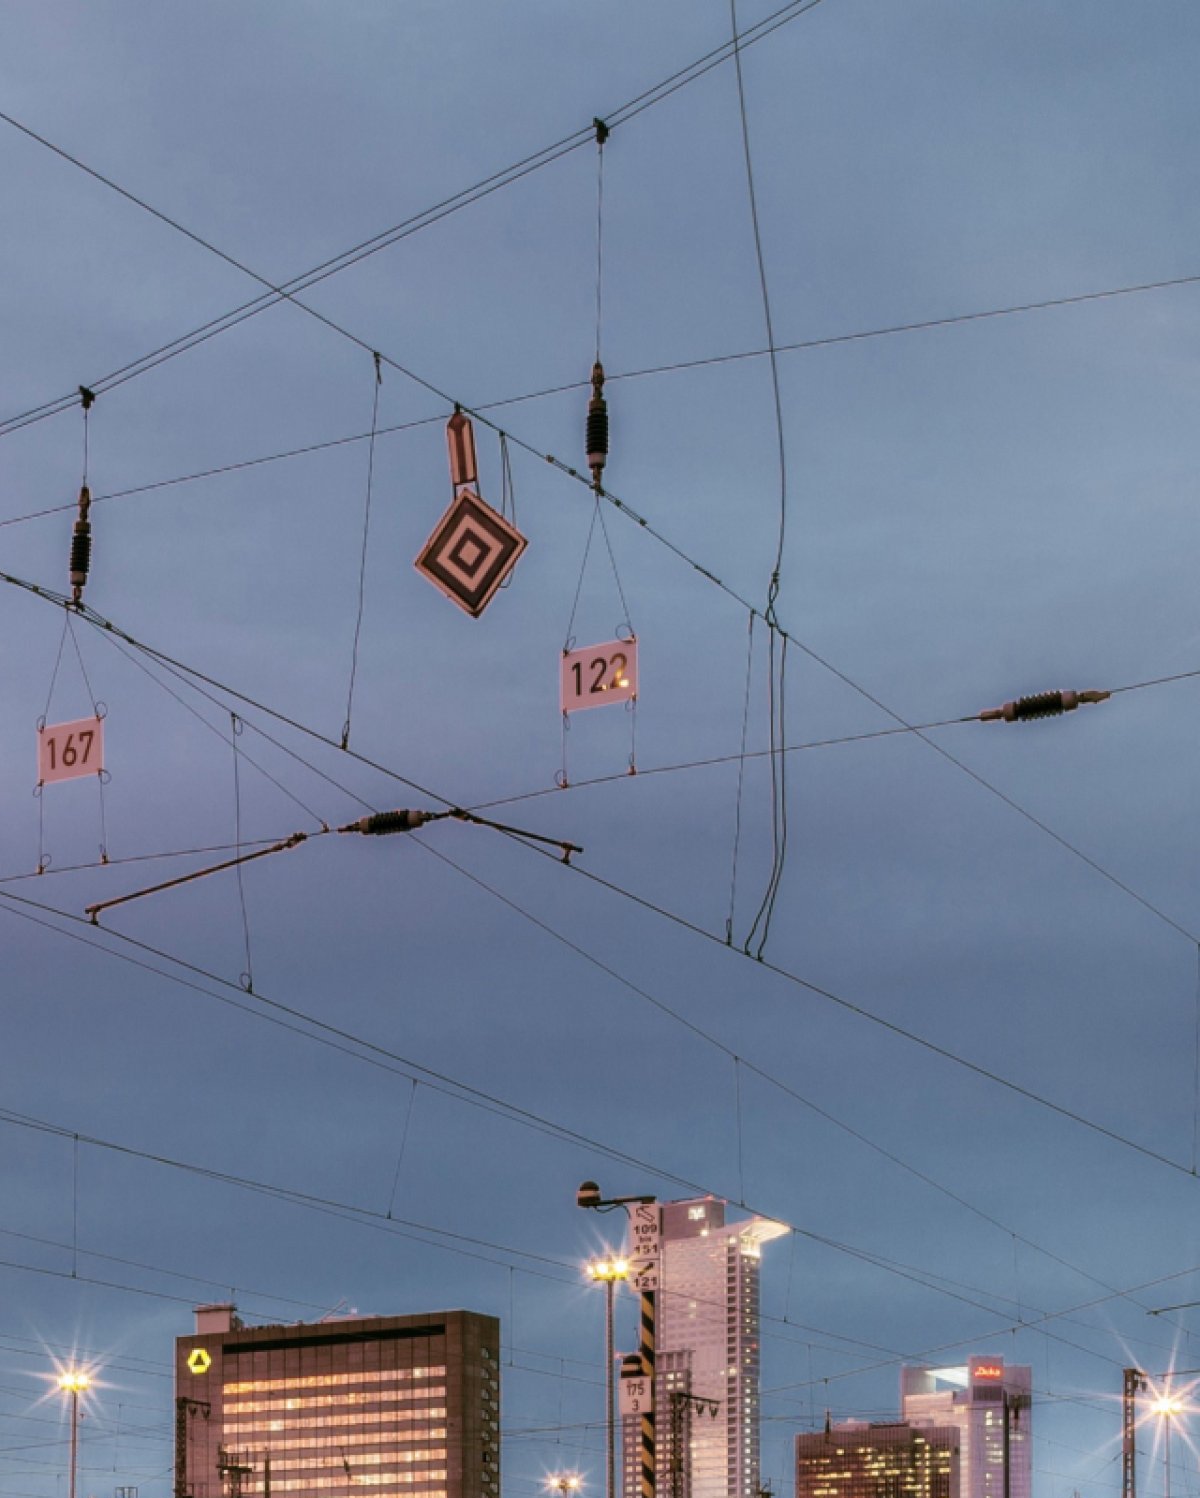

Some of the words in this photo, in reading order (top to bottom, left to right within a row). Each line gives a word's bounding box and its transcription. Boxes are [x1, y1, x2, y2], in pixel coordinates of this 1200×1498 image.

[571, 653, 629, 697] 122
[47, 730, 94, 769] 167
[634, 1224, 658, 1235] 109
[633, 1276, 658, 1288] 121
[626, 1380, 645, 1396] 175
[631, 1399, 639, 1412] 3
